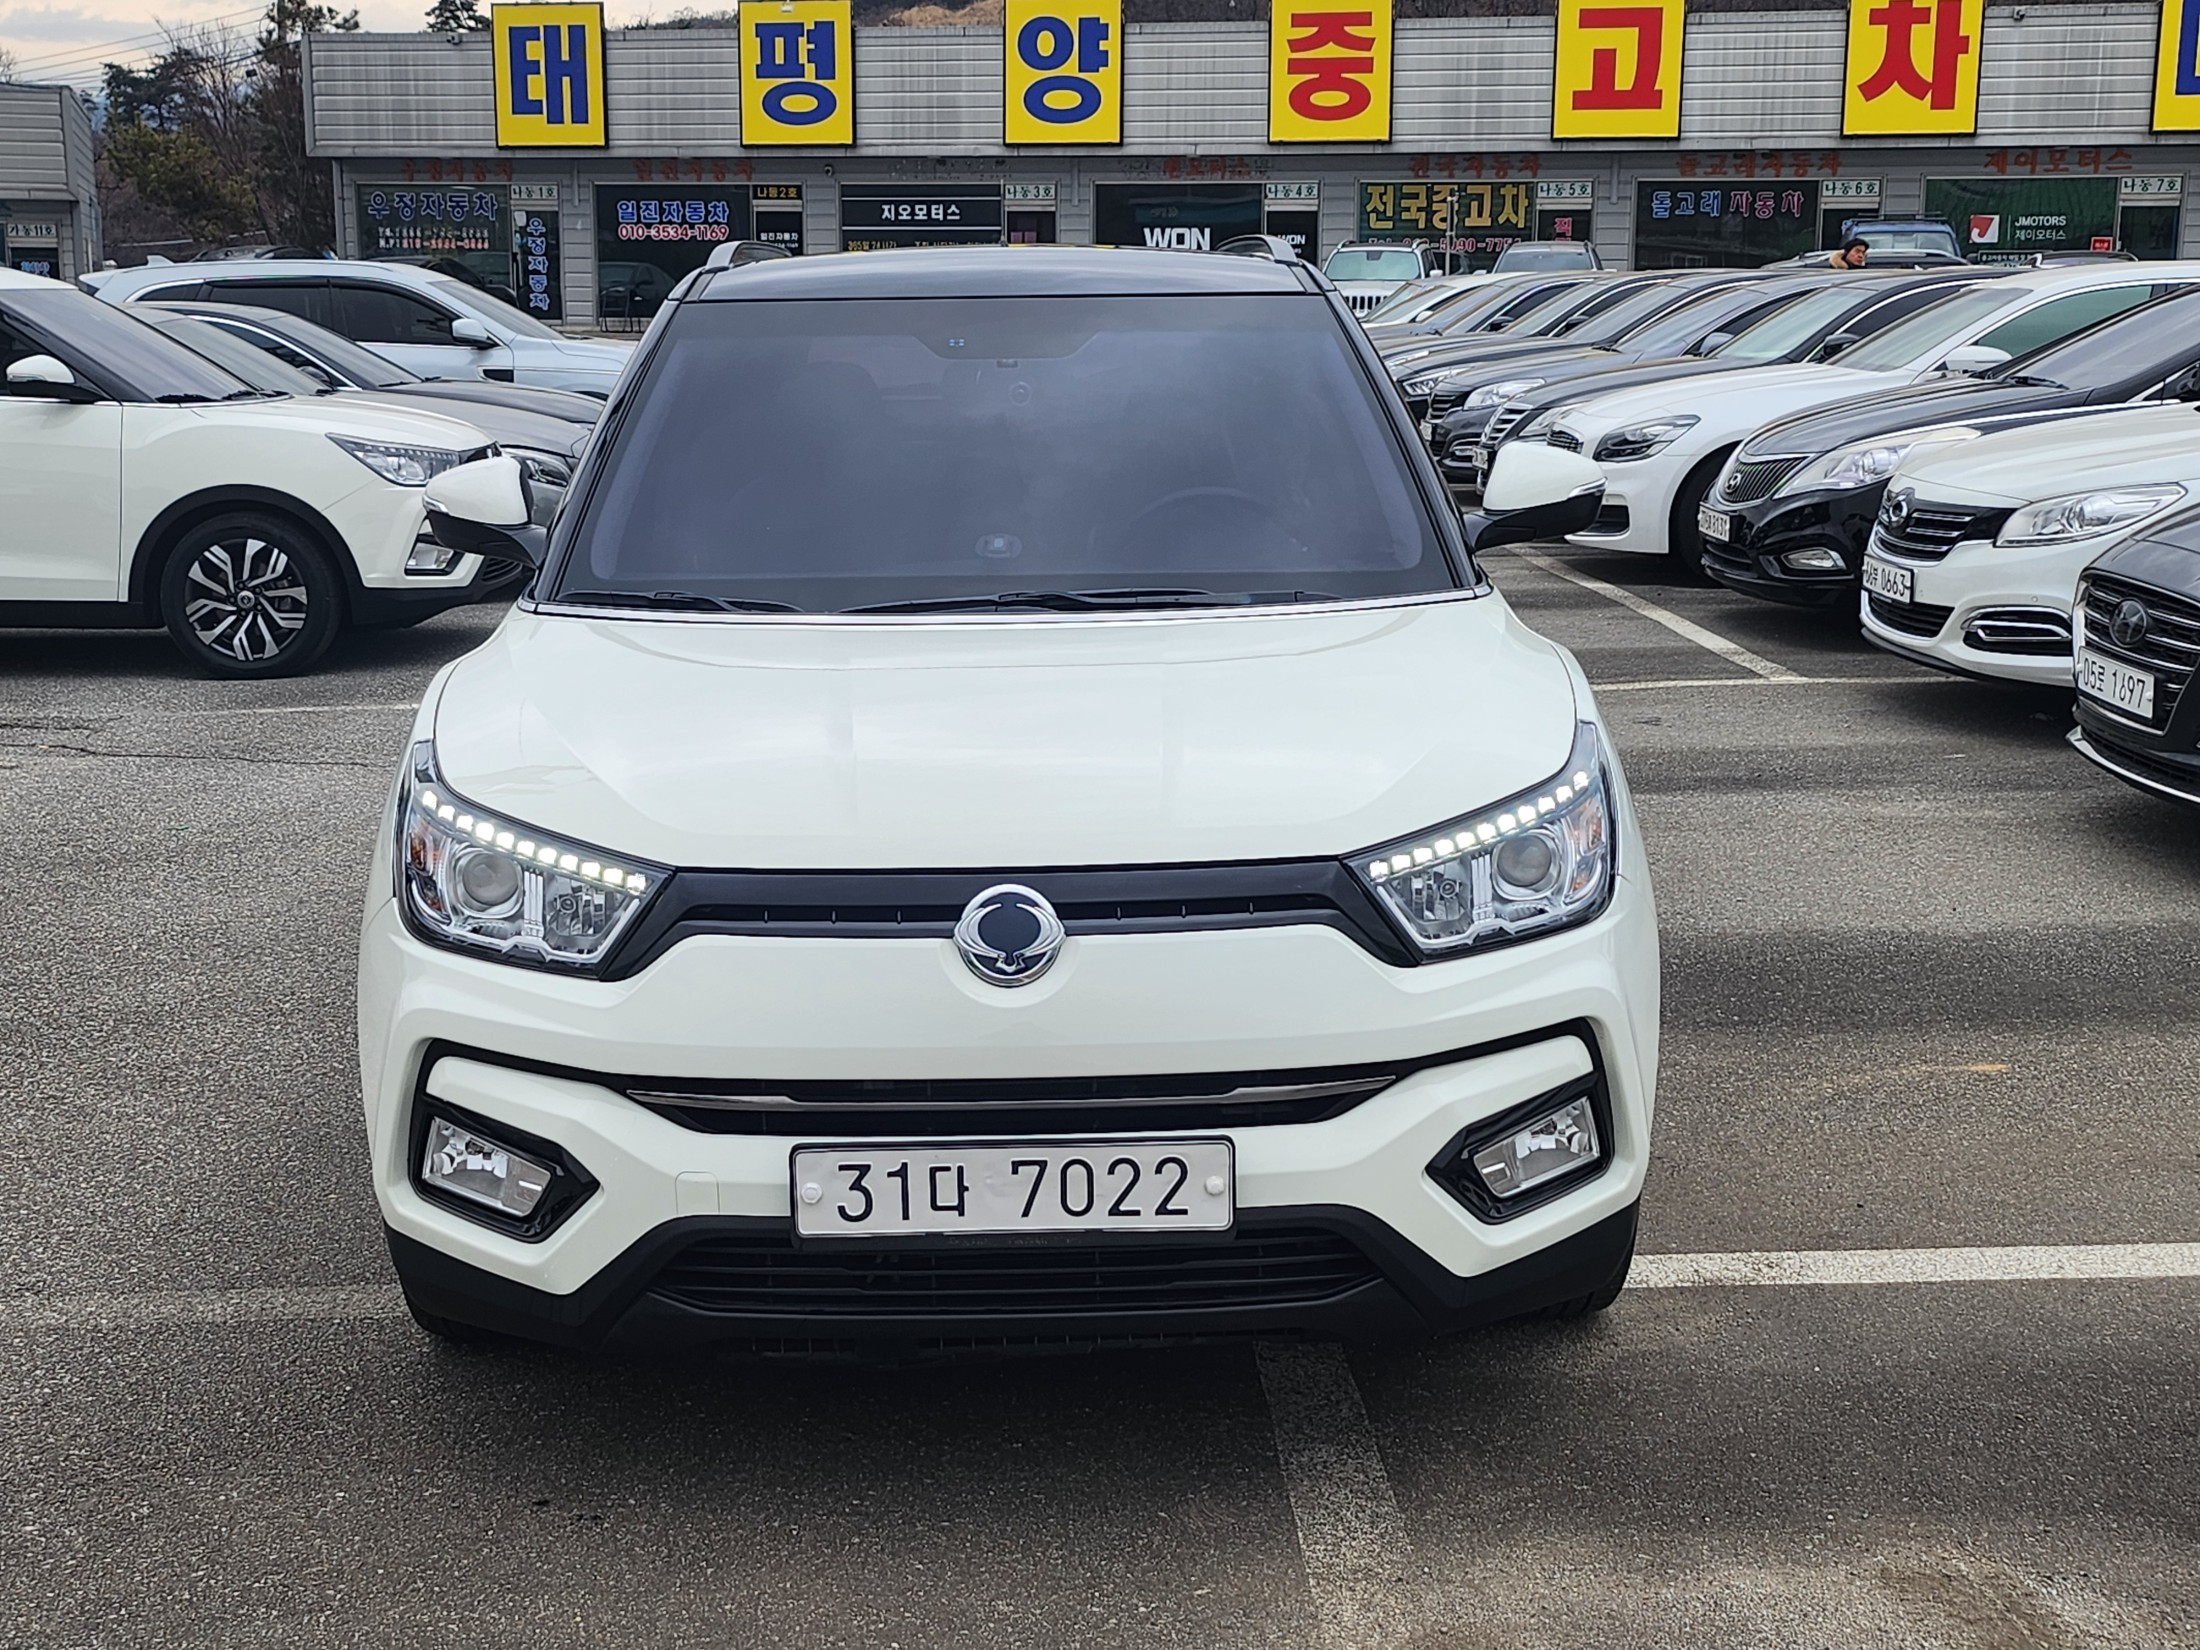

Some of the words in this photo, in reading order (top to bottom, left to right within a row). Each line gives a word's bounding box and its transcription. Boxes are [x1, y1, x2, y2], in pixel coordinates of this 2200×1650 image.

[508, 24, 589, 125] 태
[754, 20, 837, 126] 평
[1016, 15, 1109, 125] 양
[1286, 10, 1376, 121] 중
[1572, 6, 1663, 110] 고
[1857, 0, 1970, 111] 차
[1984, 149, 2133, 174] 제이모터스
[368, 191, 498, 221] 우정자동차
[617, 201, 729, 223] 일진자동차
[881, 204, 960, 221] 지오모터스
[1366, 184, 1529, 230] 전국중고차
[1652, 190, 1722, 218] 돌고래
[618, 224, 729, 240] 010-3534-1169
[2015, 216, 2067, 226] JMOTORS
[1143, 228, 1210, 250] WON
[527, 218, 550, 310] 우정자동차
[1881, 568, 1905, 597] 0663
[2112, 669, 2145, 708] 1697
[837, 1161, 970, 1223] 31다
[1011, 1156, 1189, 1219] 7022
